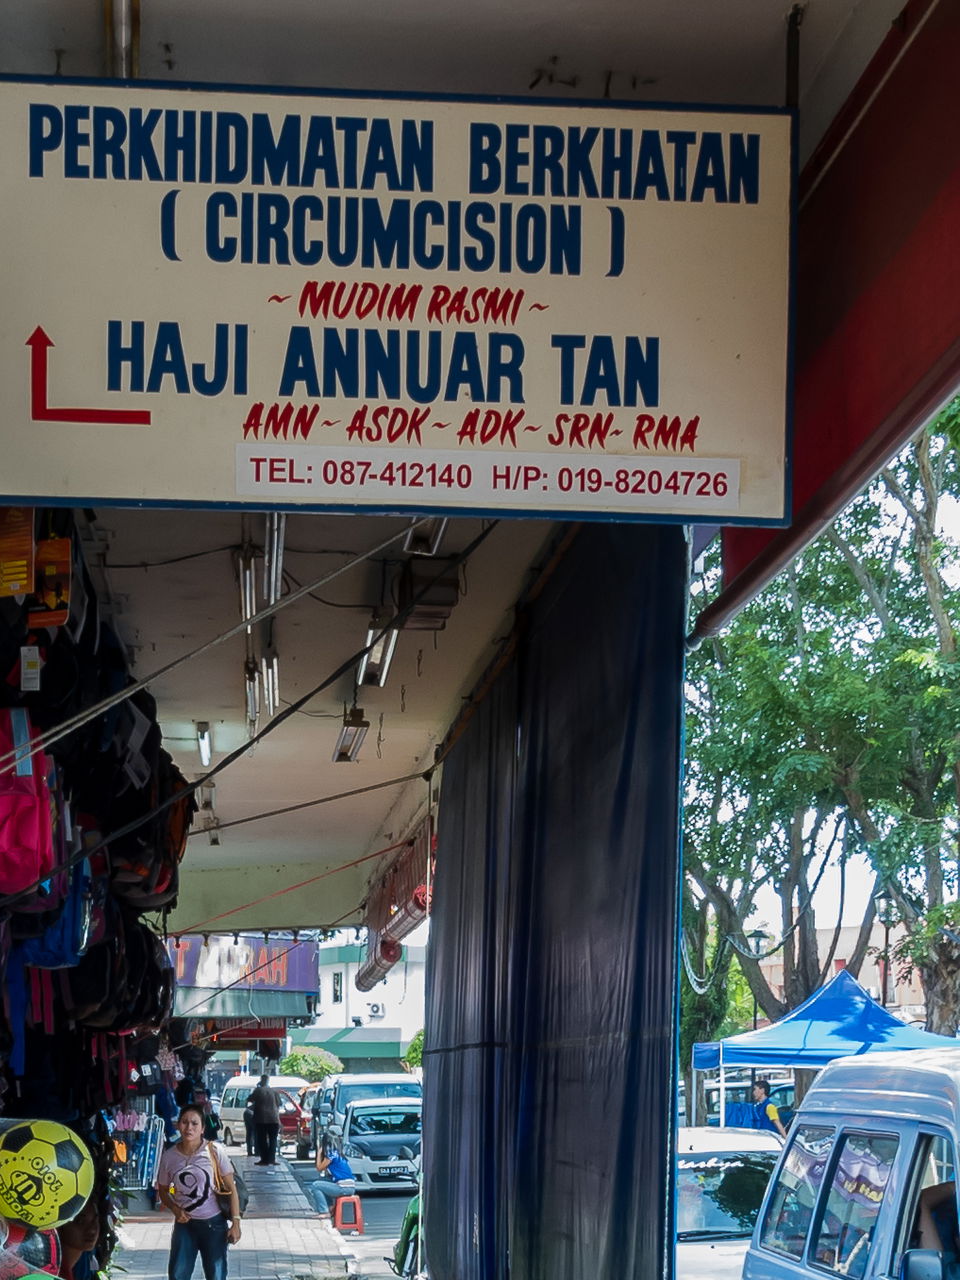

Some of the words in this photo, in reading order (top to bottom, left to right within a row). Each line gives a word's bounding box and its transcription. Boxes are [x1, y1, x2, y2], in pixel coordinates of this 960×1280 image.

[29, 103, 434, 192] PERKHIDMATAN
[469, 122, 761, 204] BERKHATAN
[205, 191, 581, 276] CIRCUMCISION
[299, 281, 423, 323] MUDIM
[427, 284, 524, 327] RASMI
[107, 320, 248, 396] HAJI
[278, 326, 525, 404] ANNUAR
[551, 334, 659, 407] TAN
[243, 401, 320, 441] AMN
[346, 404, 431, 447] ASDK
[457, 408, 525, 448] ADK
[548, 412, 614, 449] SRN
[632, 414, 700, 452] RMA
[250, 457, 312, 484] TEL:
[322, 460, 472, 489] 087-412140
[493, 465, 548, 491] H/P:
[557, 468, 728, 497] 019-8204726
